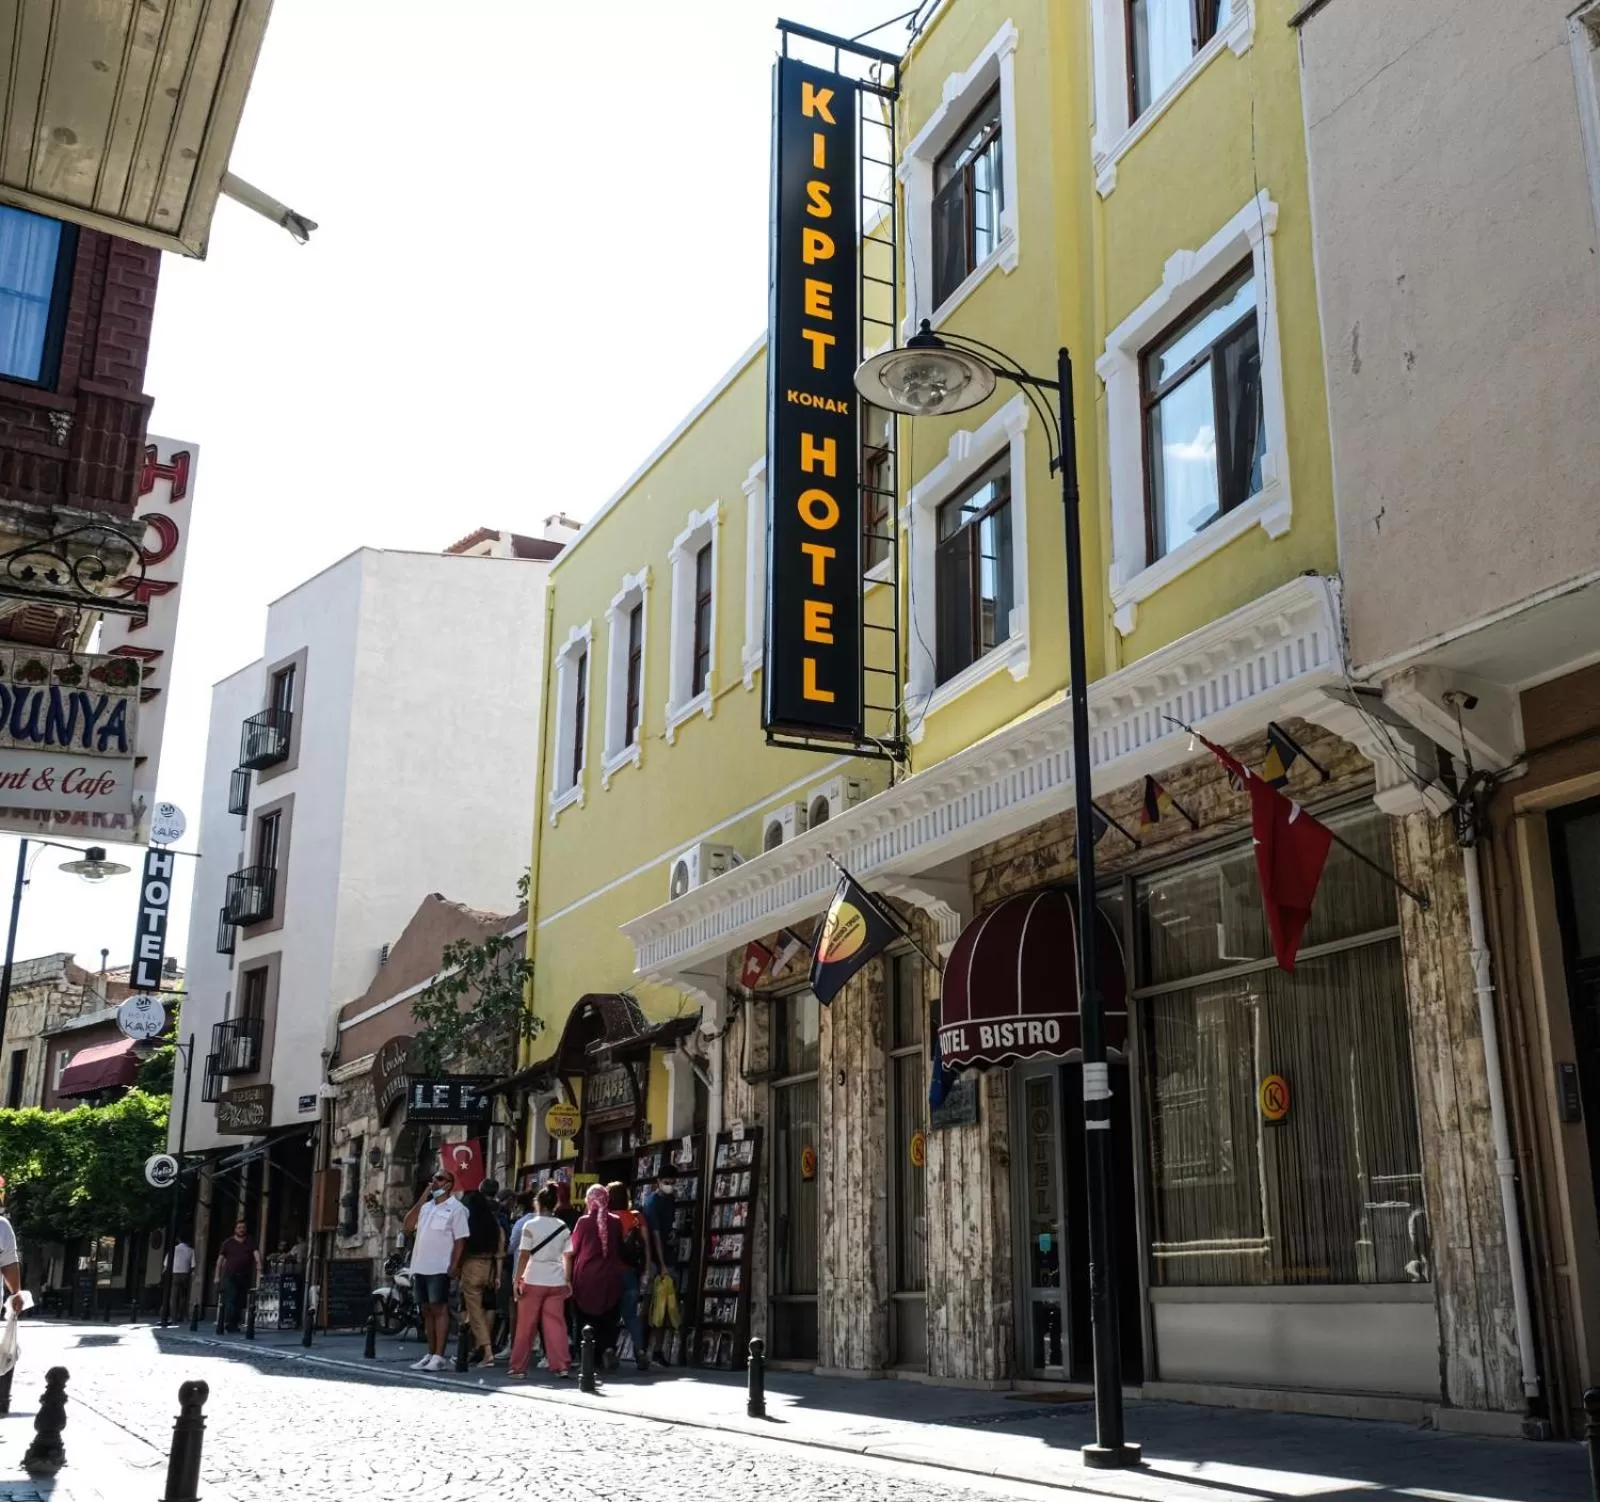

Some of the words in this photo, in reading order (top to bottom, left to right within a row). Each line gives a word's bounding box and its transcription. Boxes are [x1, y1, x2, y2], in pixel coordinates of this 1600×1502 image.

[801, 81, 836, 370] KISPET
[787, 389, 849, 415] KONAK
[797, 431, 840, 703] HOTEL
[32, 767, 55, 792] &
[61, 767, 116, 800] Cafe
[136, 851, 173, 987] HOTEL
[979, 1019, 1061, 1049] BISTRO
